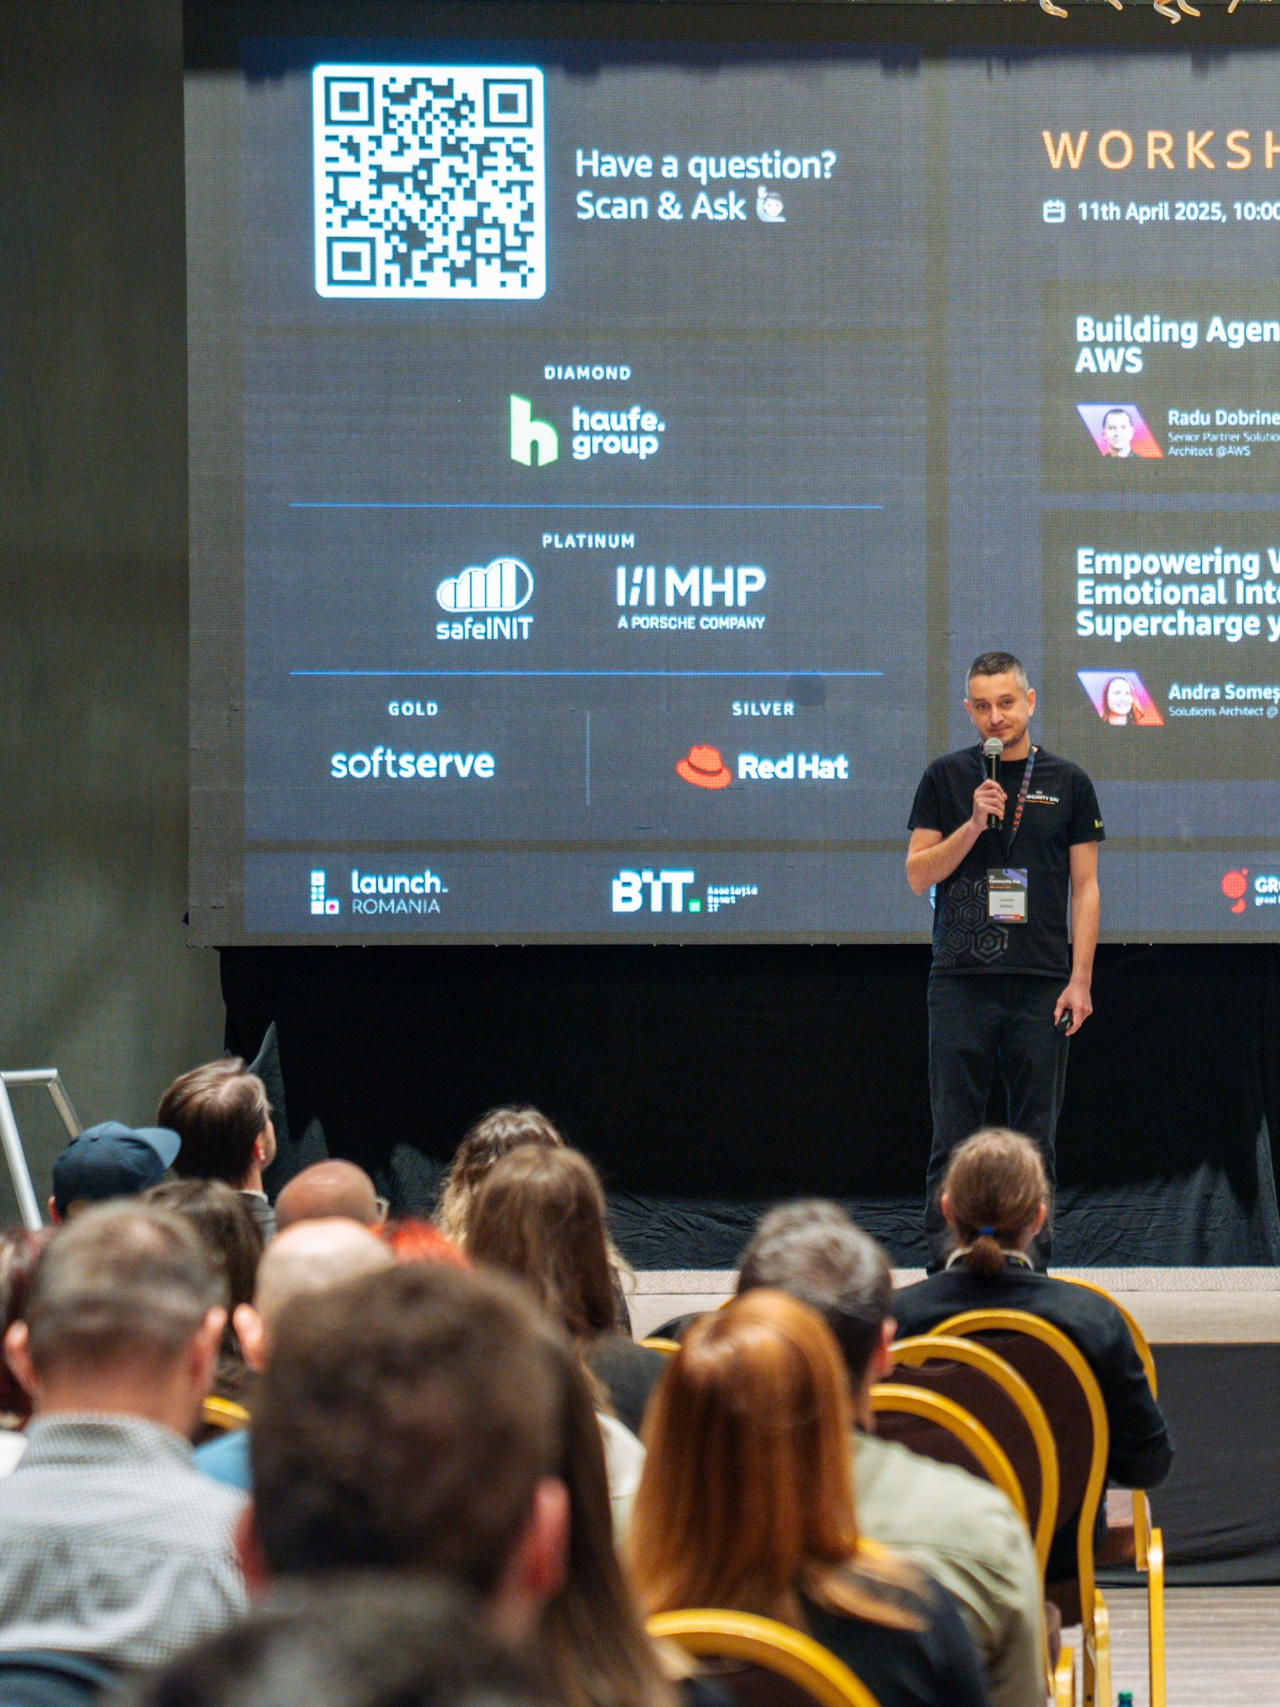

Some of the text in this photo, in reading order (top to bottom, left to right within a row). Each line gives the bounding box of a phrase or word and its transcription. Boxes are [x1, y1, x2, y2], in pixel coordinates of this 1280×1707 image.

[576, 149, 837, 183] Have a question?
[576, 190, 747, 221] Scan & Ask
[1078, 201, 1121, 221] 11th
[1124, 201, 1171, 225] April
[1174, 201, 1227, 223] 2025,
[1076, 314, 1199, 349] Building
[544, 365, 631, 381] DIAMOND
[1074, 348, 1143, 374] AWS
[1168, 409, 1211, 426] Radu
[572, 434, 660, 461] group
[1167, 431, 1201, 443] Senior
[1202, 432, 1241, 443] Partner
[1167, 445, 1251, 459] Architect @AWS
[542, 533, 635, 549] PLATINUM
[1077, 546, 1260, 581] Empowering
[664, 566, 767, 607] MHP
[1077, 578, 1228, 605] Emotional
[436, 615, 534, 640] safeINIT
[617, 615, 766, 630] A PORSCHE COMPANY
[1076, 608, 1261, 643] Supercharge
[1168, 683, 1221, 700] Andra
[387, 701, 438, 716] GOLD
[732, 701, 794, 716] SILVER
[1168, 706, 1217, 717] Solutions
[1218, 706, 1264, 717] Architect
[1266, 705, 1279, 719] @
[331, 745, 495, 779] softserve
[737, 753, 849, 780] Red Hat
[352, 898, 441, 915] ROMANIA
